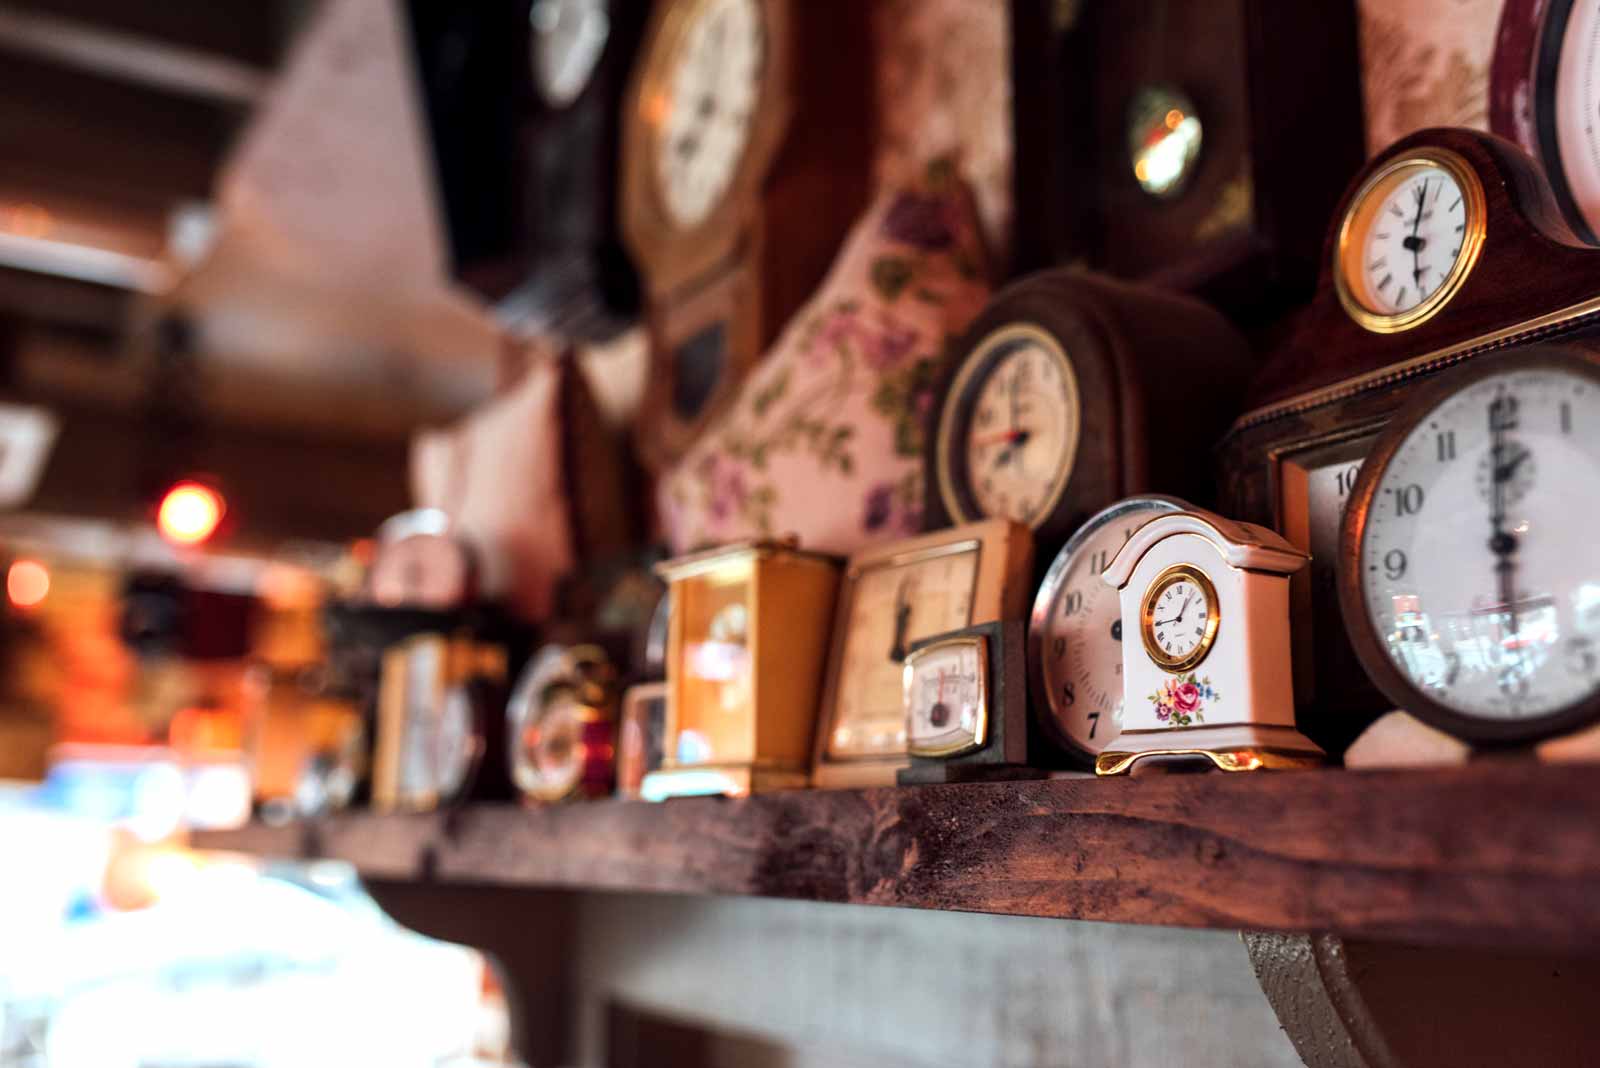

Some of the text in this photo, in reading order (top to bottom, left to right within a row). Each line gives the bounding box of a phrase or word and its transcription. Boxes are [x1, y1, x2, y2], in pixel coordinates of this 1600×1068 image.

[1395, 484, 1424, 517] 10
[1384, 549, 1408, 581] 9
[1062, 682, 1075, 708] 8
[1087, 711, 1100, 740] 7
